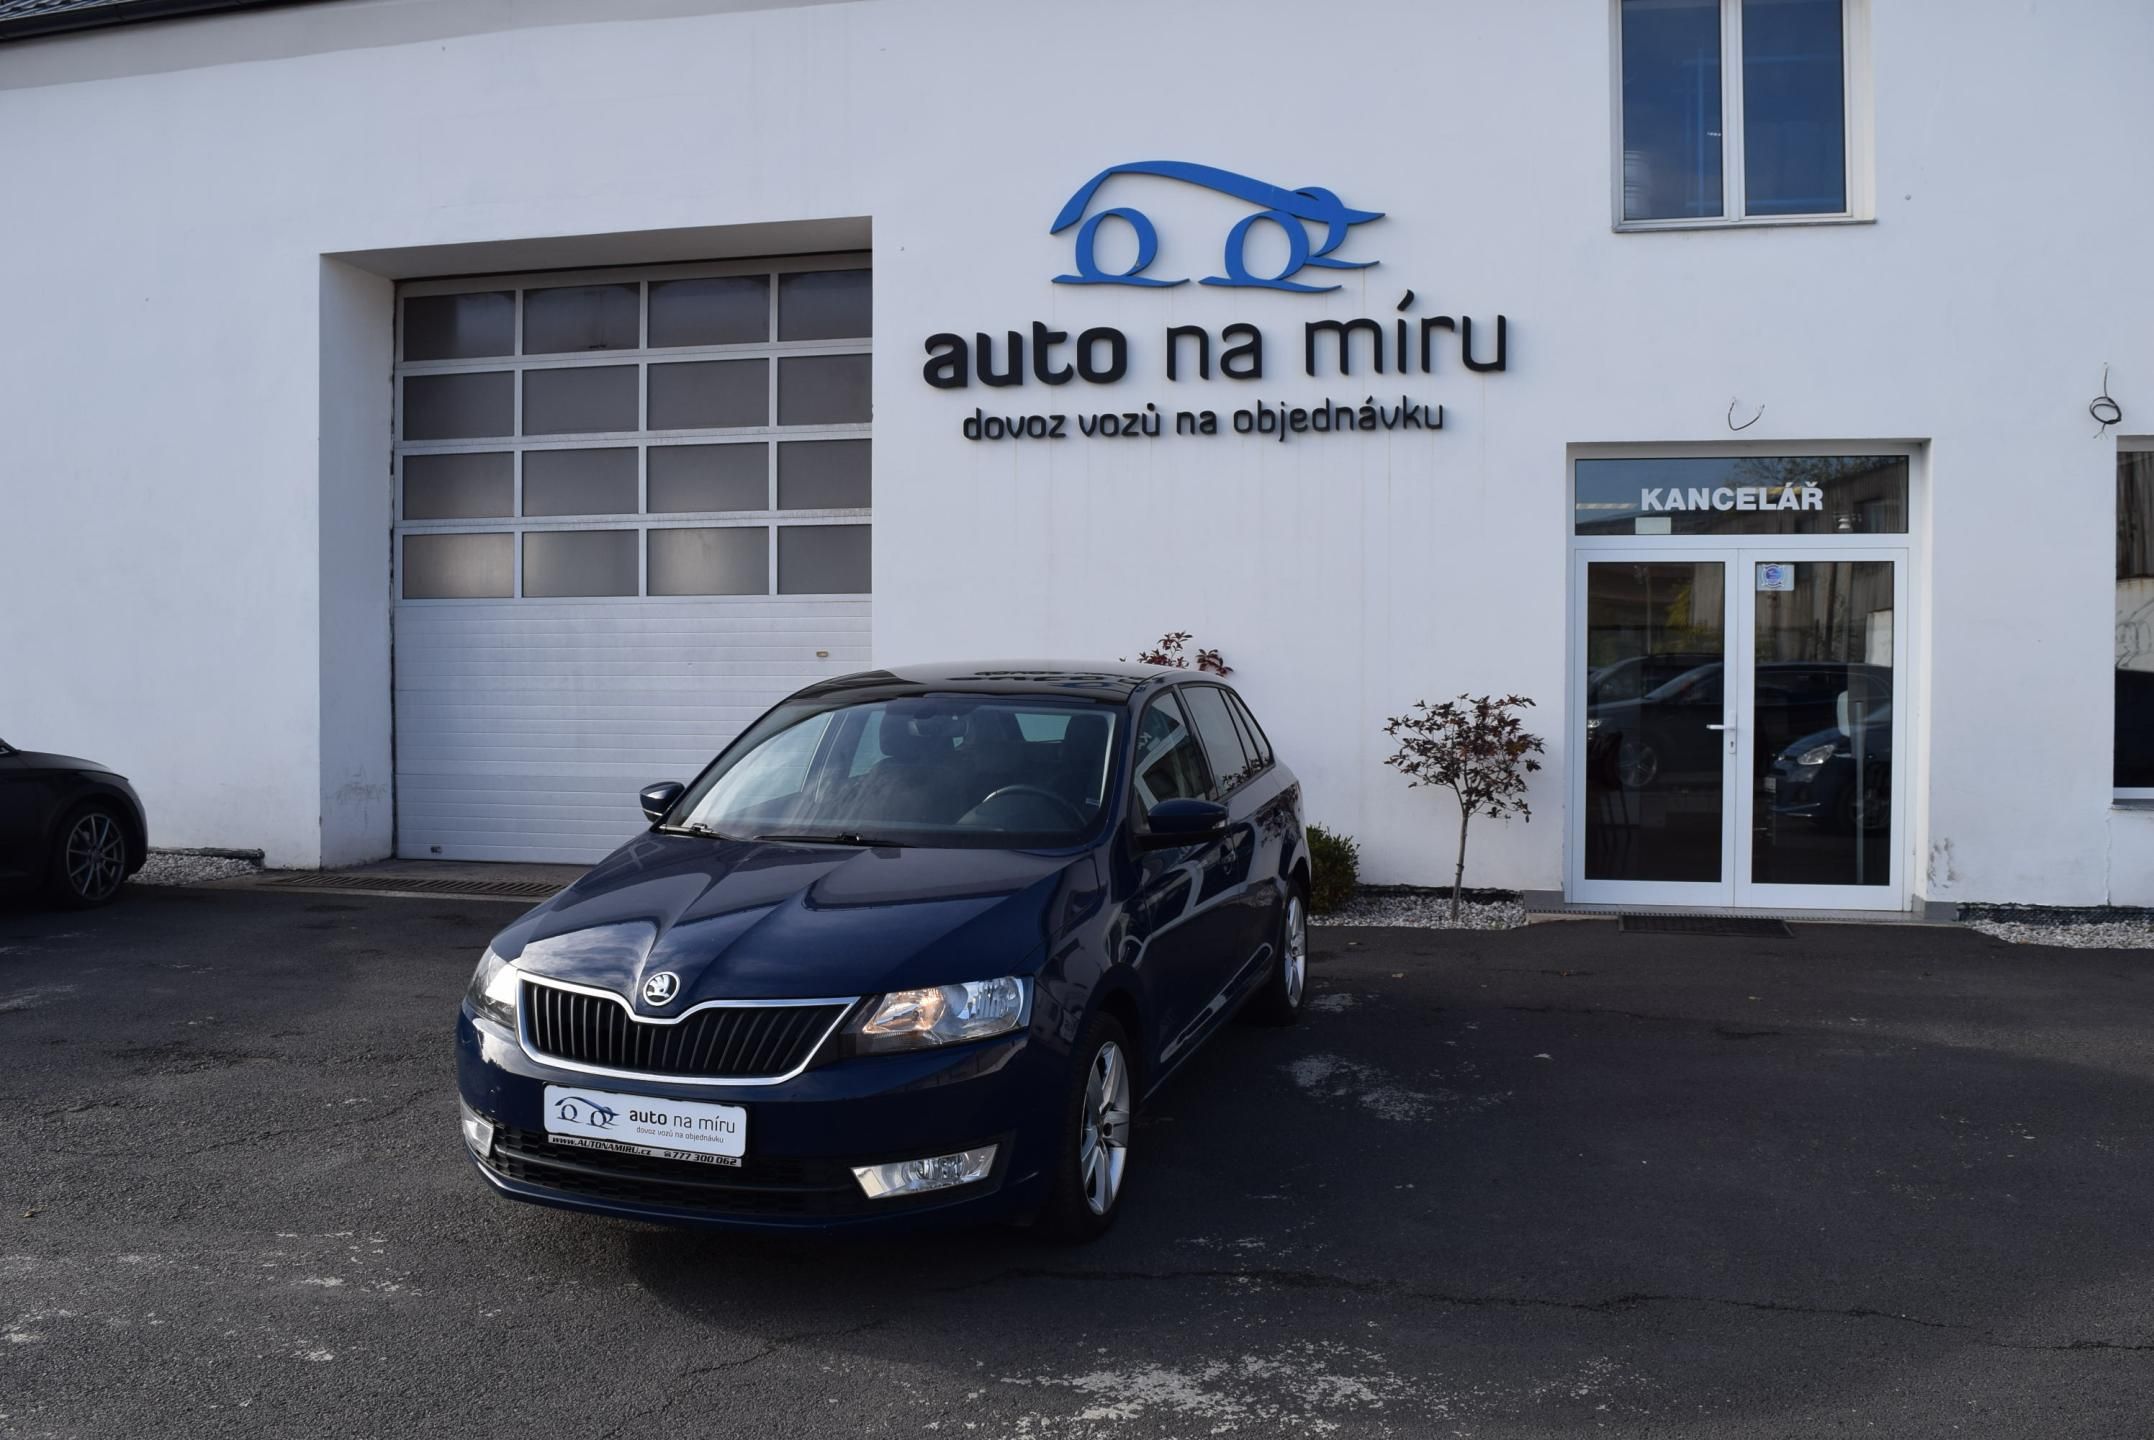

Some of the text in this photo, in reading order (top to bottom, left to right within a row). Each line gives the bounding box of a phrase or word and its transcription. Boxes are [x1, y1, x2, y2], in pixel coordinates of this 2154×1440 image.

[923, 289, 1507, 390] auto na míru
[963, 394, 1444, 443] dovoz vozů na objednávku
[1641, 481, 1823, 511] KANCELÁŘ
[629, 1109, 736, 1134] auto na míru
[636, 1126, 724, 1143] dovoz vozů na objednávku
[673, 1151, 691, 1160] 777
[694, 1154, 714, 1163] 300
[716, 1157, 737, 1166] 062
